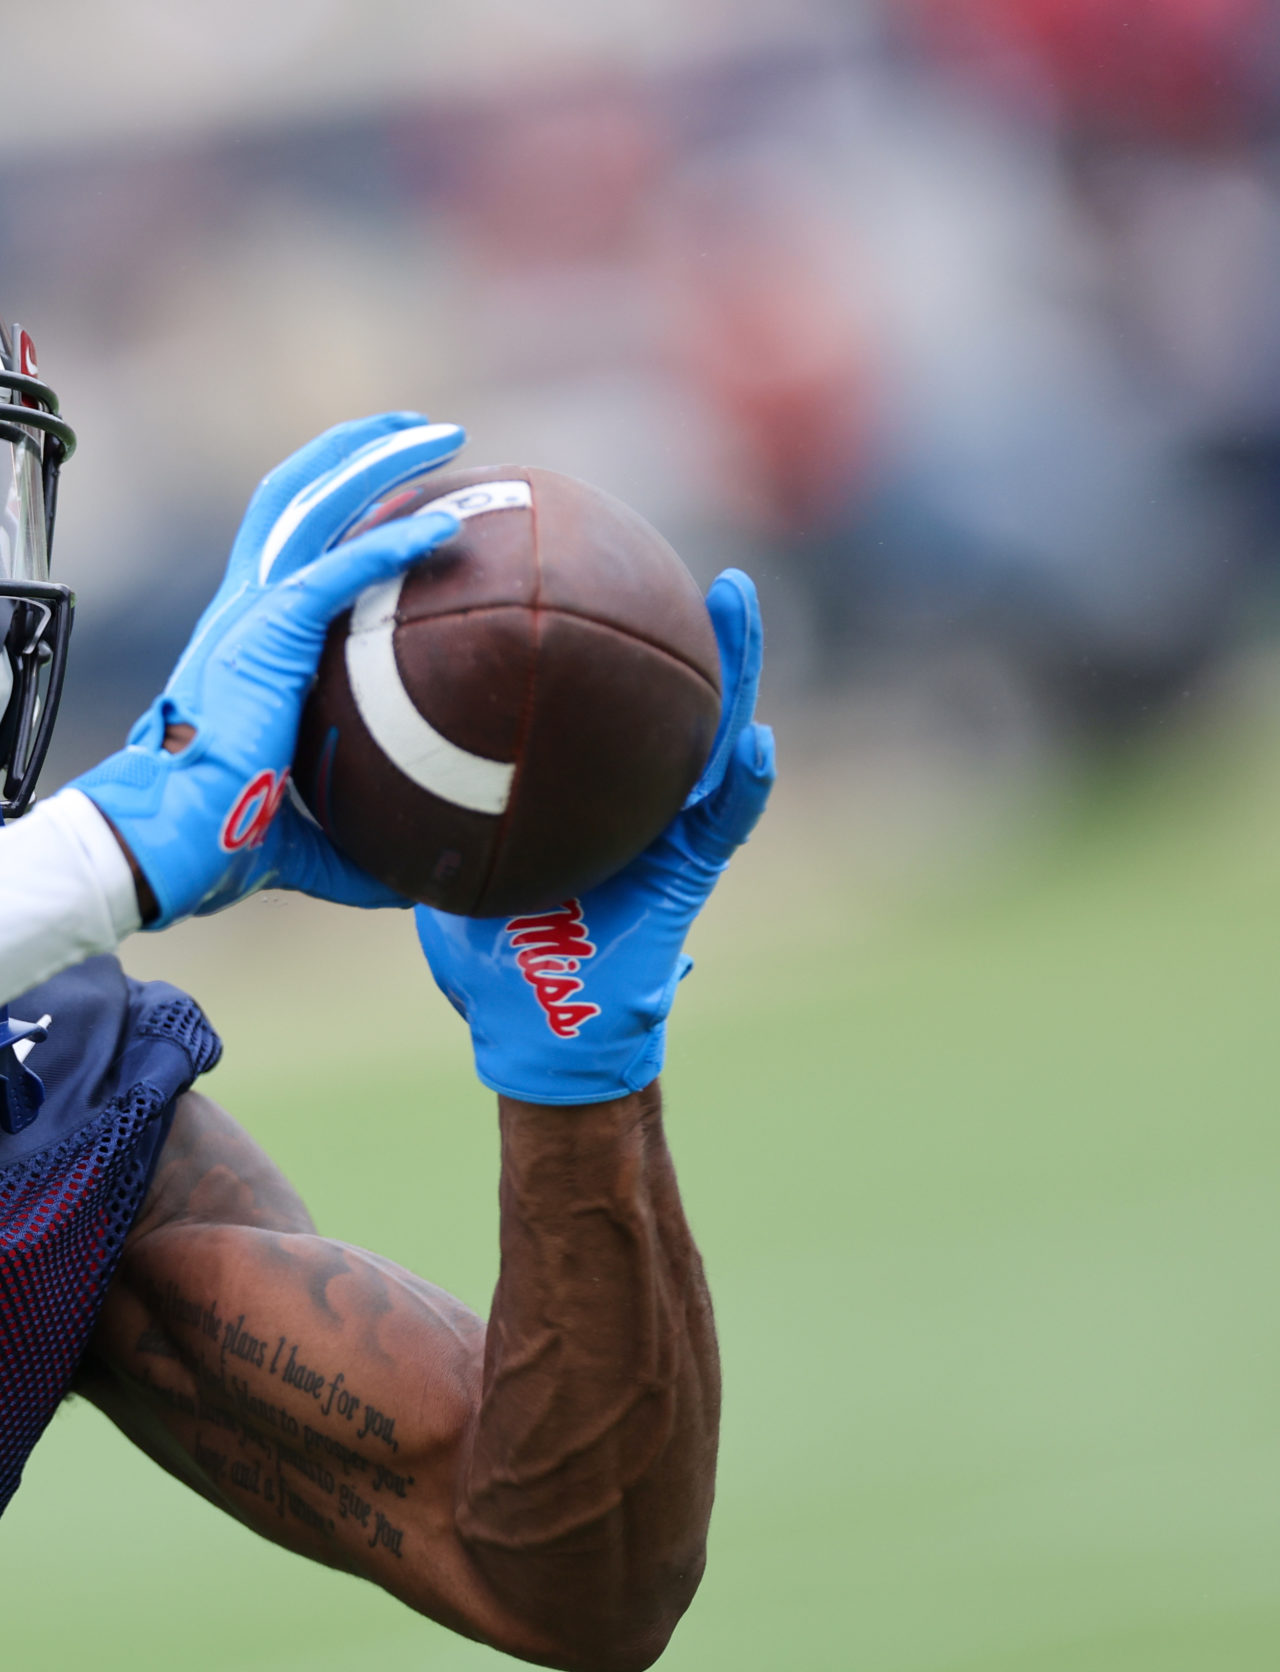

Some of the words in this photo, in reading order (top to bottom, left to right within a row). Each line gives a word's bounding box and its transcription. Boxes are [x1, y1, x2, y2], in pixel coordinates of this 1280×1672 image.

[505, 897, 601, 1038] Miss
[222, 1315, 268, 1367] plans
[282, 1344, 325, 1400] have
[321, 1372, 360, 1421] for
[357, 1405, 399, 1453] you,
[279, 1407, 299, 1437] to
[338, 1483, 371, 1528] give
[368, 1511, 404, 1558] you
